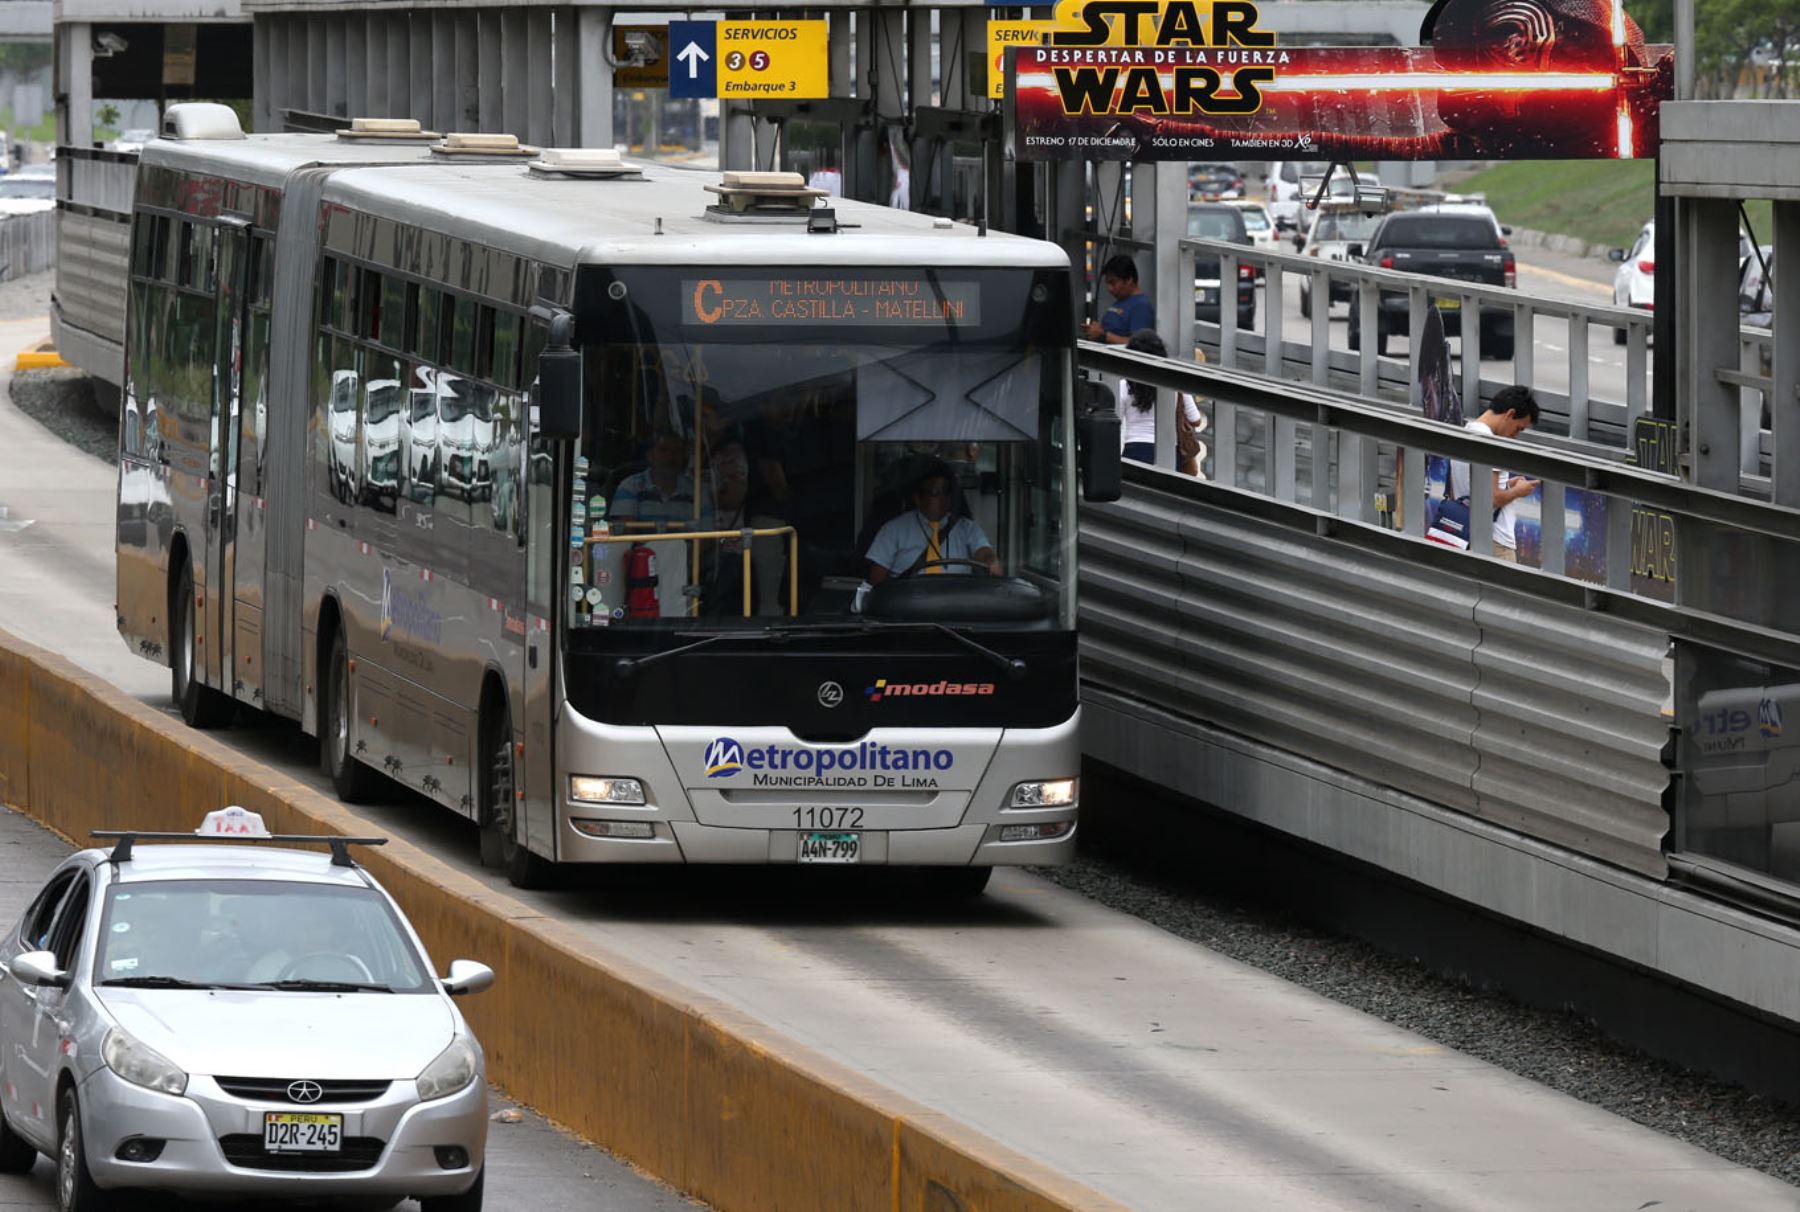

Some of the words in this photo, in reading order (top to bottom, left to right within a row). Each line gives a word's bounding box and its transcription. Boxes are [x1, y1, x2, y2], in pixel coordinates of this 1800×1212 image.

[1052, 0, 1277, 48] STAR
[724, 28, 798, 40] SERVICIOS
[728, 52, 742, 69] 3
[753, 52, 767, 69] 5
[1037, 50, 1145, 63] DESPERTAR
[1154, 51, 1176, 63] DE
[1186, 51, 1207, 63] LA
[1217, 51, 1290, 63] FUERZA
[725, 81, 785, 93] Embarque
[789, 81, 797, 91] 3
[1052, 65, 1276, 115] WARS
[1026, 137, 1065, 146] ESTRENO
[1068, 137, 1077, 146] 17
[1078, 137, 1089, 146] DE
[1090, 137, 1136, 146] DICIEMBRE
[1179, 139, 1189, 147] EN
[1190, 139, 1214, 147] CINES
[1269, 139, 1280, 148] EN
[769, 280, 920, 296] METROPOLITANO
[694, 280, 723, 324] C
[771, 300, 856, 319] CASTILLA
[875, 300, 964, 319] MATELLINI
[885, 681, 995, 696] modasa
[704, 737, 954, 778] Metropolitano
[793, 807, 864, 828] 11072
[801, 840, 858, 858] A4N-799
[290, 1115, 318, 1123] PERU
[268, 1123, 338, 1146] D2R-245
